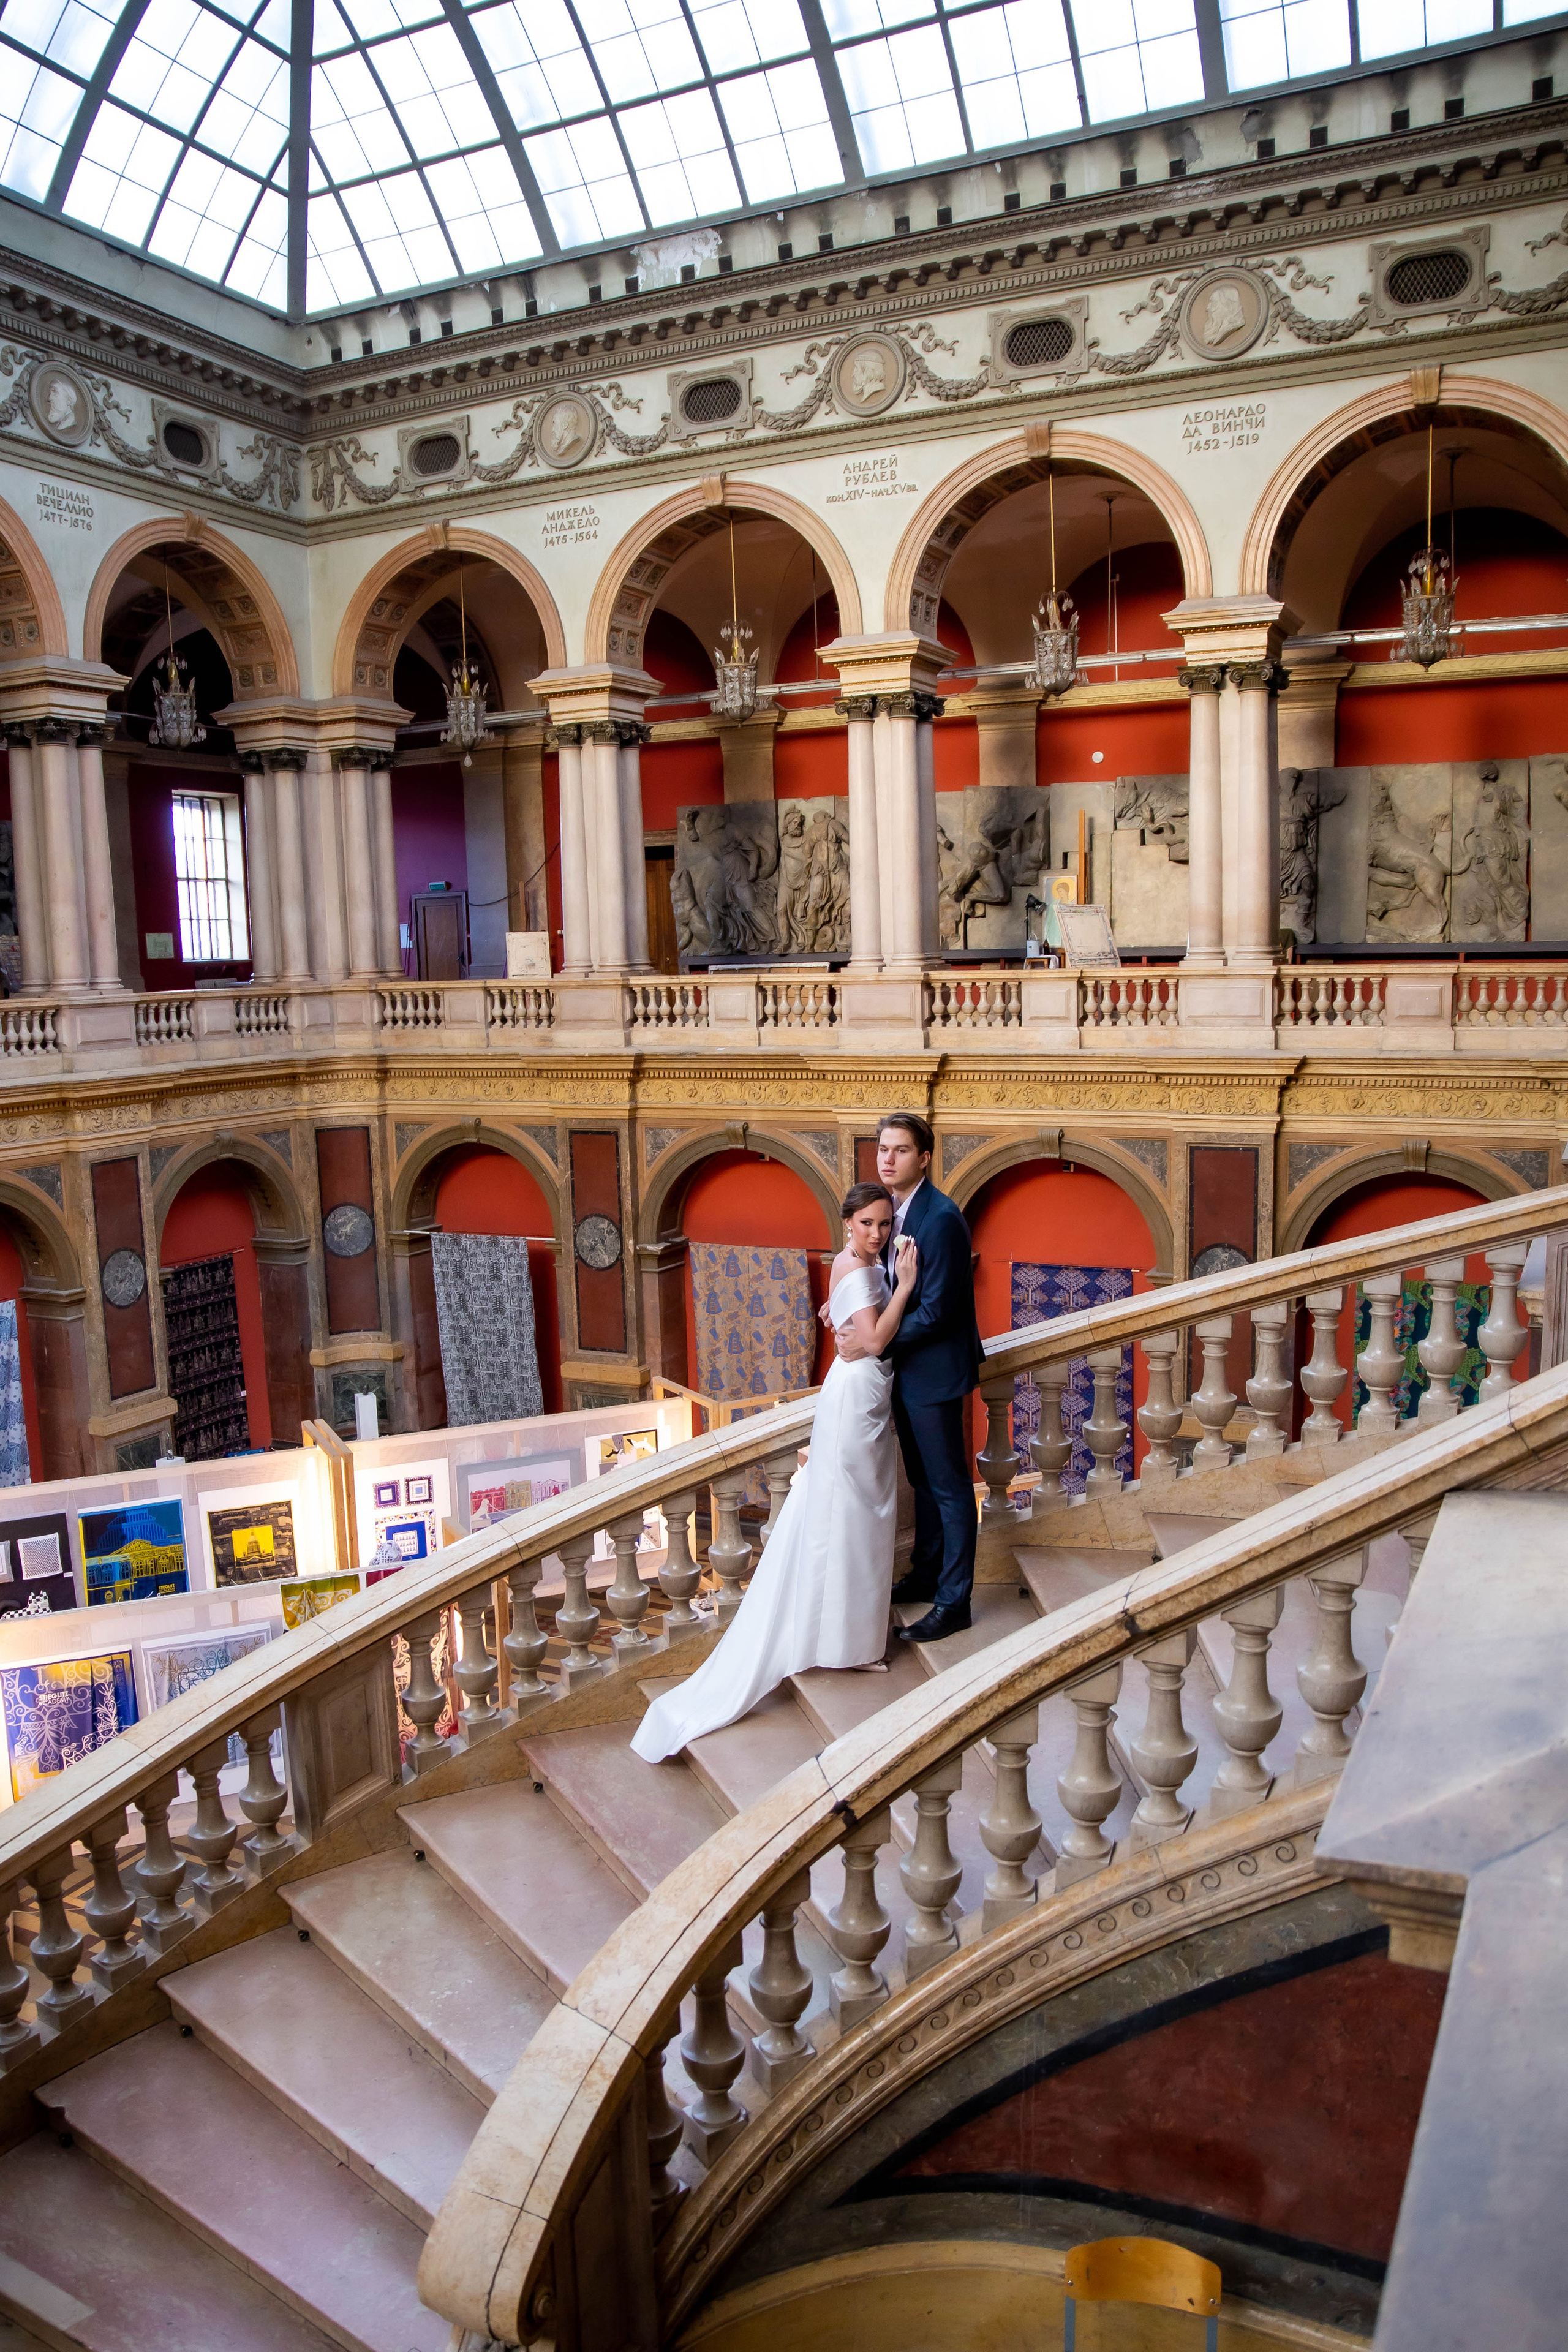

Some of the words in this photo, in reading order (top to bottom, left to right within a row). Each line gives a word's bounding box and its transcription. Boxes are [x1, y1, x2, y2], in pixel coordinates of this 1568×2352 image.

[1182, 403, 1266, 425] ЛЕОНАРДО
[1182, 425, 1202, 439] ДА
[1212, 416, 1265, 434] ВИНЧИ
[843, 454, 899, 474] АНДРЕЙ
[845, 470, 897, 486] РУБЛЕВ
[39, 482, 90, 505] ТИЦИАН
[37, 494, 94, 518] ВЕЧЕЛЛИО
[546, 505, 595, 522] МИКЕЛЬ
[541, 516, 600, 534] АНДЖЕЛО
[38, 1697, 69, 1706] ACADEMY
[39, 1691, 69, 1701] STIEGLITZ
